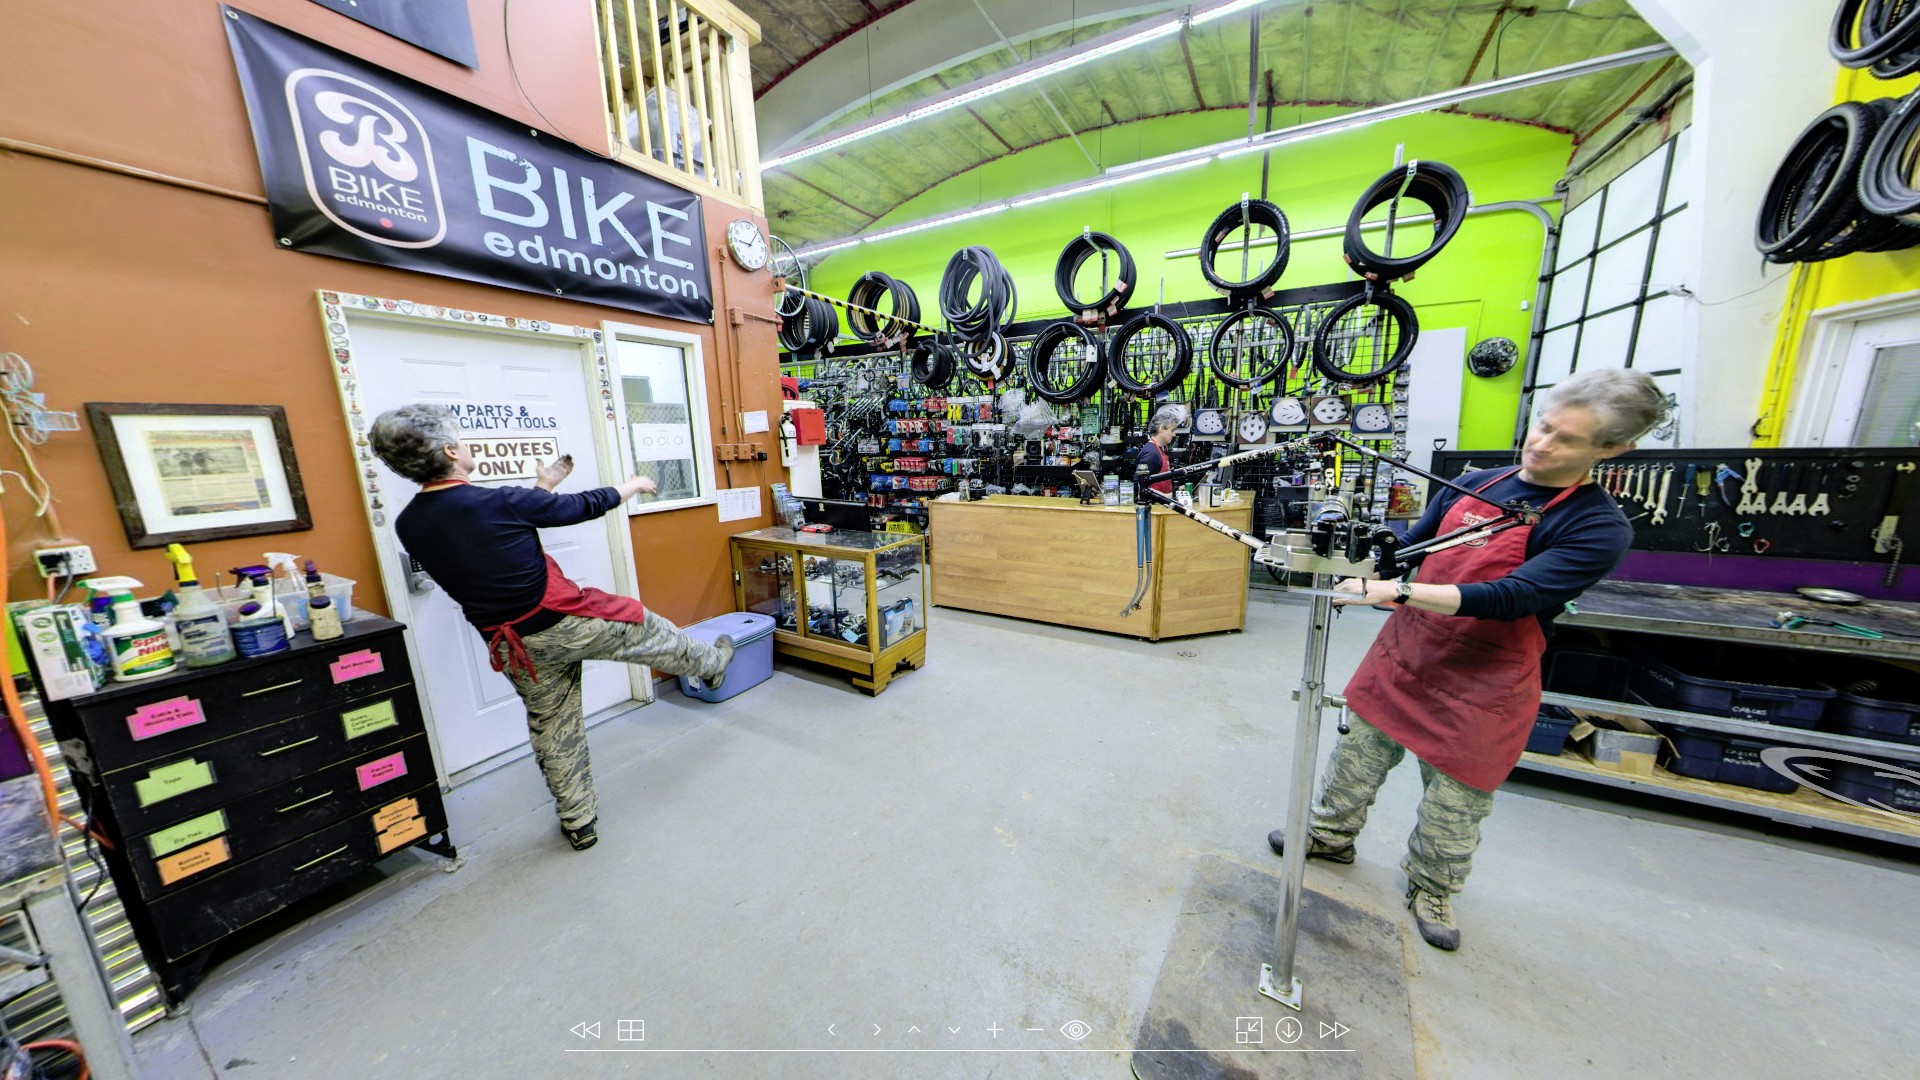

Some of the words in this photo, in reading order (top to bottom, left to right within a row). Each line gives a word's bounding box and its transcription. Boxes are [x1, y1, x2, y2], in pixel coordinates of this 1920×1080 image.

[328, 165, 425, 213] BIKE
[466, 135, 695, 272] BIKE
[333, 192, 428, 224] edmonton
[483, 231, 700, 300] edmonton
[459, 416, 509, 429] CIALTY
[515, 417, 557, 429] TOOLS
[466, 404, 513, 417] PARTS
[519, 406, 529, 417] &
[469, 442, 554, 458] PLOYEES
[1235, 453, 1259, 465] LOVE
[1259, 445, 1285, 457] THIS
[1286, 438, 1310, 450] BIKE
[478, 460, 525, 476] ONLY
[1183, 506, 1241, 541] TREK
